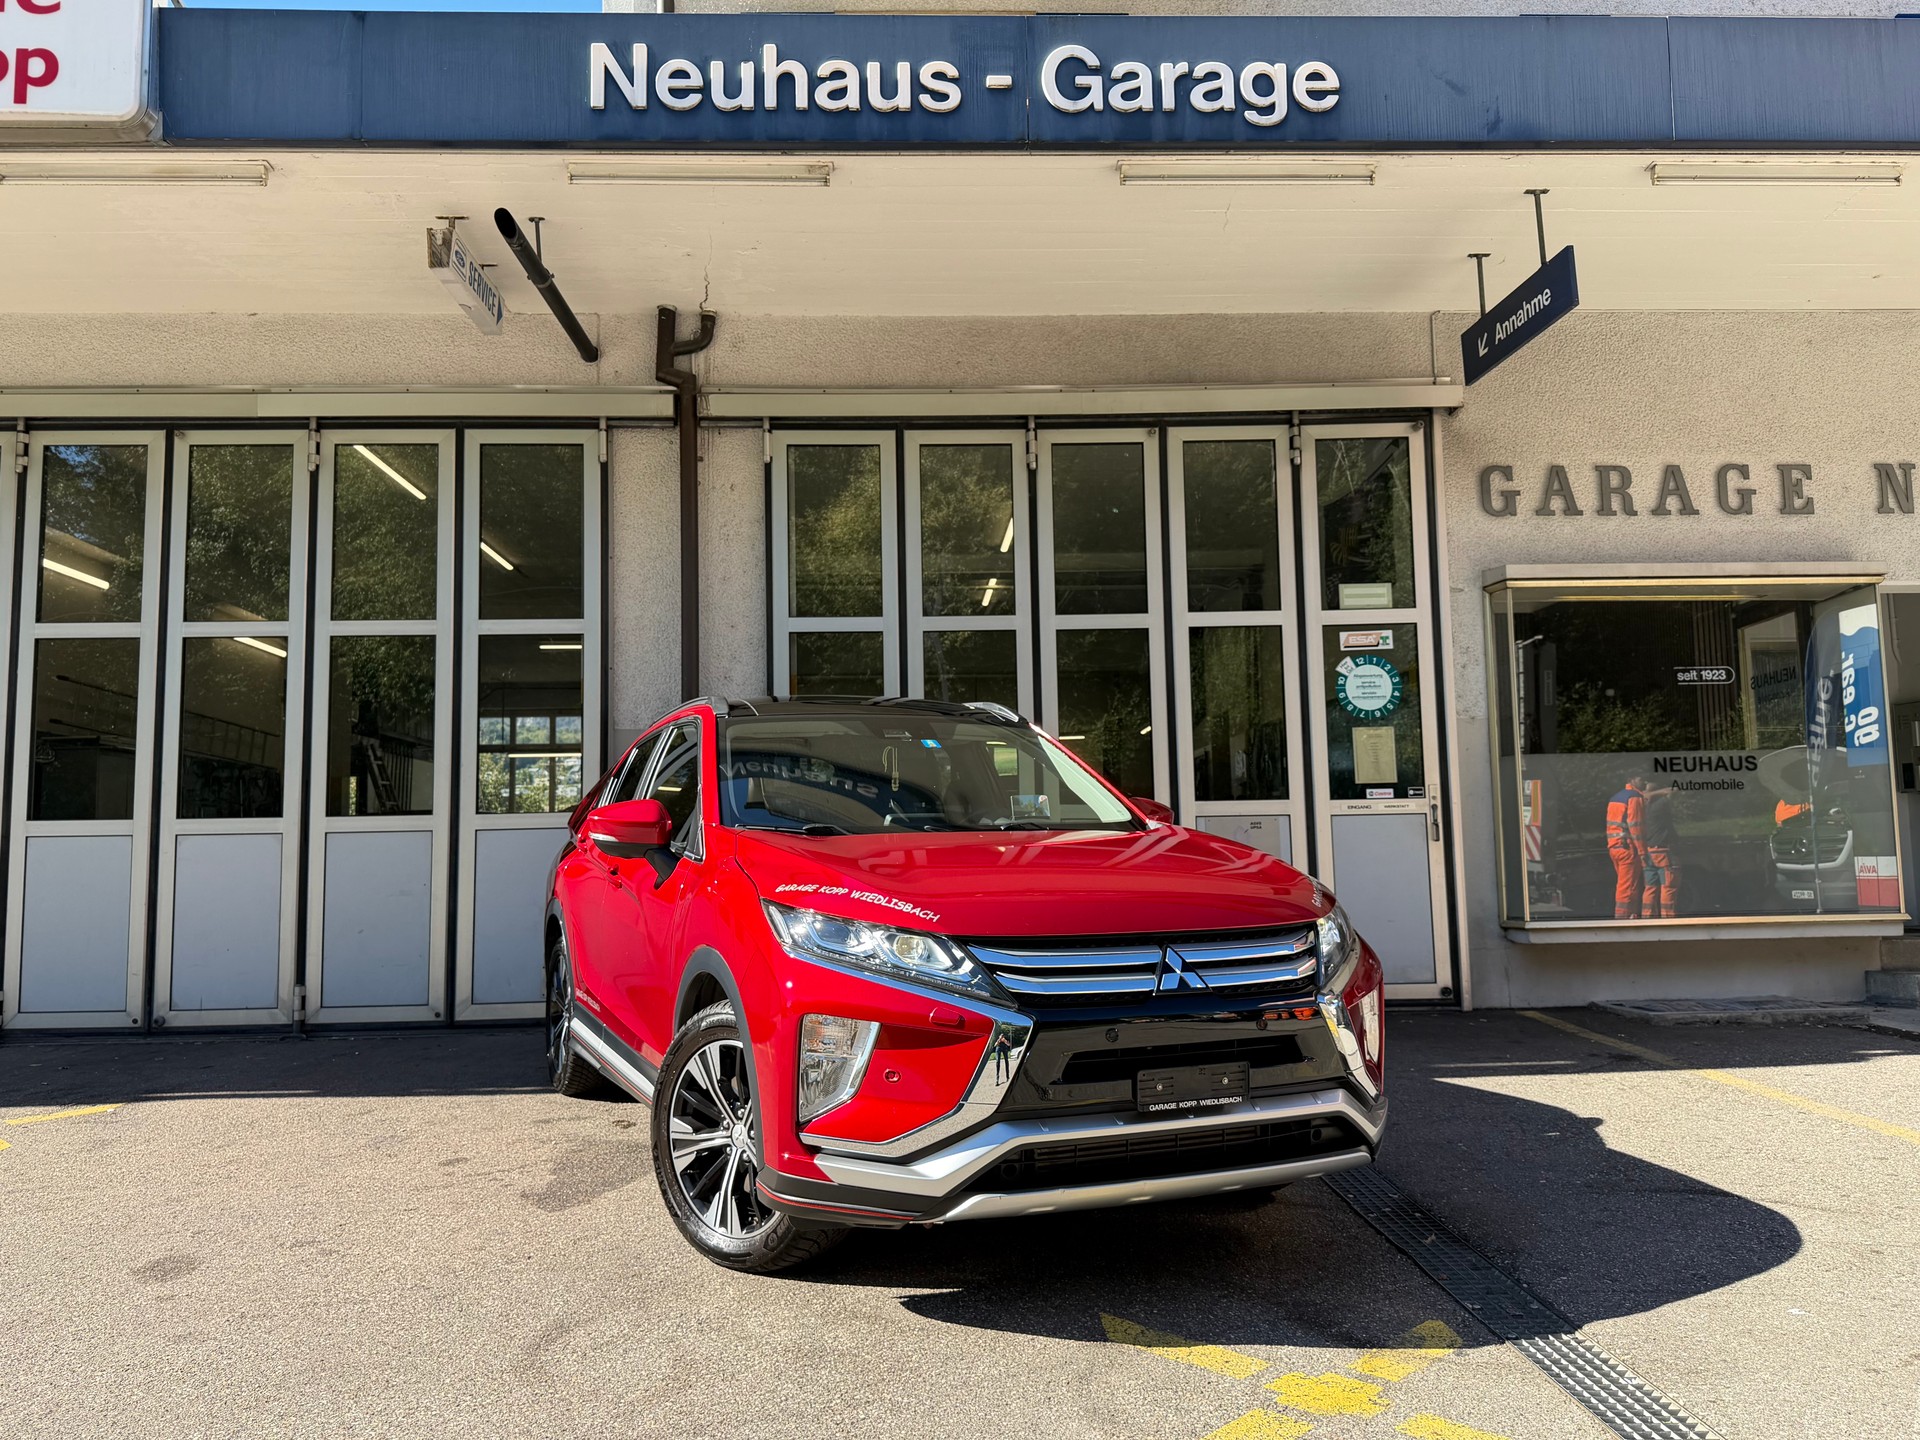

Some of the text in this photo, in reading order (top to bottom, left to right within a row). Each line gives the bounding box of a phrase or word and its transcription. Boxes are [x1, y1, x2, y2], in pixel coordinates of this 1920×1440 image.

[590, 42, 1340, 126] Neuhaus - Garage
[469, 261, 497, 317] SERVICE
[1495, 288, 1552, 345] Annahme
[1480, 463, 1815, 517] GARAGE
[1356, 657, 1365, 665] 12
[1337, 676, 1346, 685] 10
[1677, 669, 1726, 681] seit 1923
[1386, 702, 1394, 710] 5
[1374, 710, 1381, 718] 6
[1654, 755, 1758, 773] NEUHAUS
[1671, 778, 1745, 791] Automobile
[775, 884, 941, 923] GARAGE KOPP WIEDLISBACH
[1149, 1103, 1177, 1111] GARAGE
[1200, 1096, 1242, 1106] WIEDLISBACH
